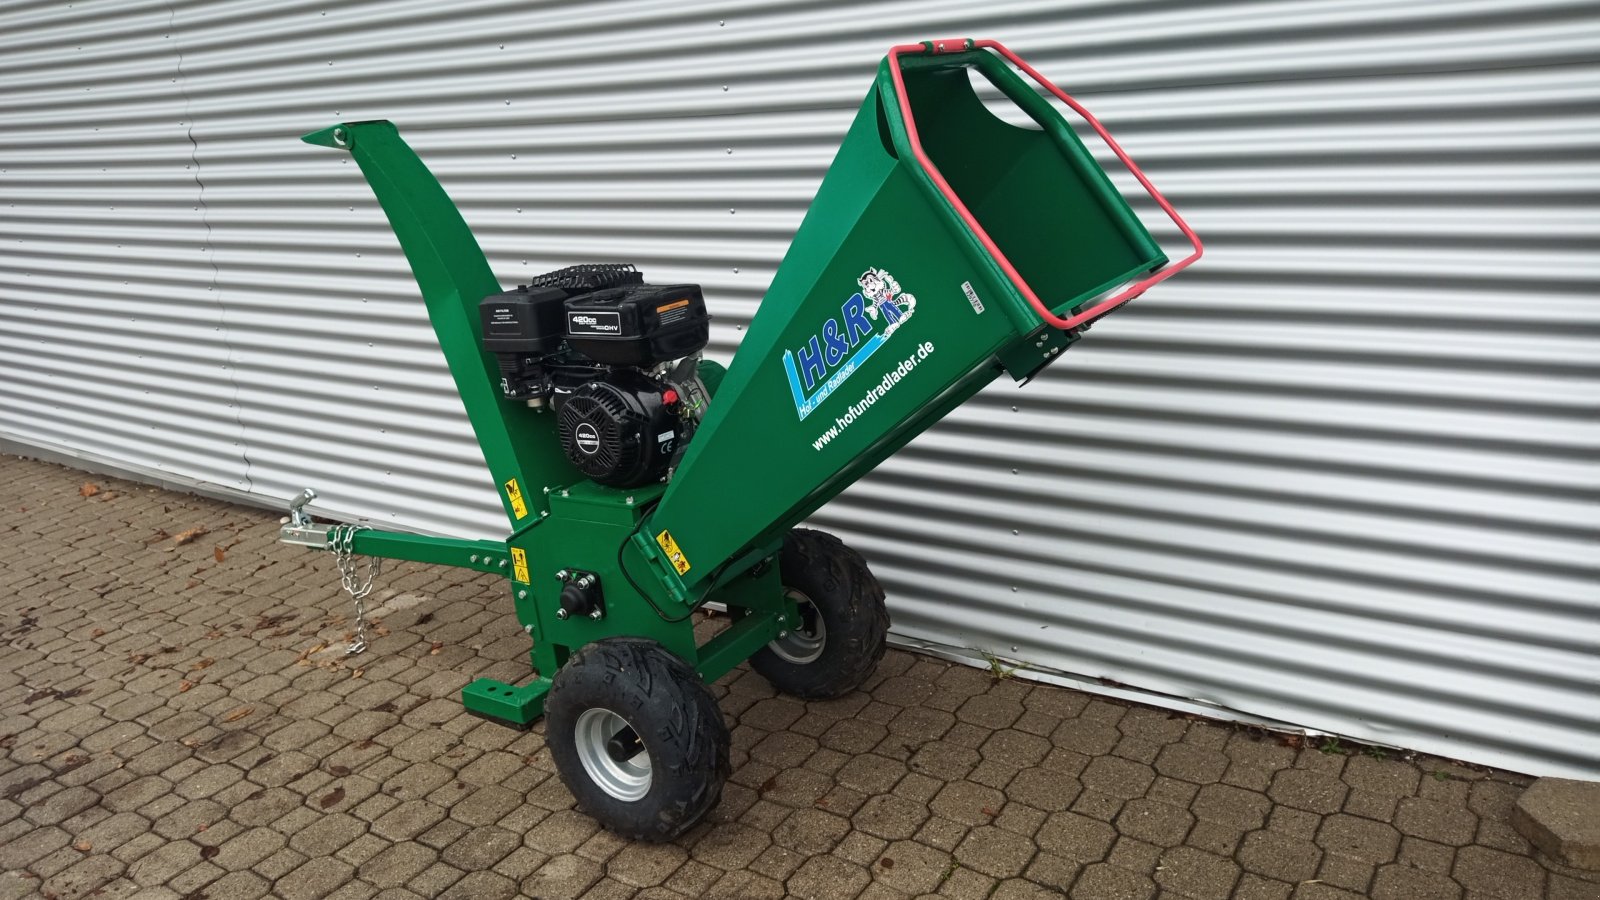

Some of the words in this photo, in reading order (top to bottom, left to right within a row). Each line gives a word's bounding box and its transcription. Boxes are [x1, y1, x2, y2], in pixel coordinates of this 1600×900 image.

[798, 293, 873, 390] H&R
[815, 385, 828, 403] und
[827, 361, 855, 392] Radlader
[812, 341, 935, 451] www.hofundradlader.de
